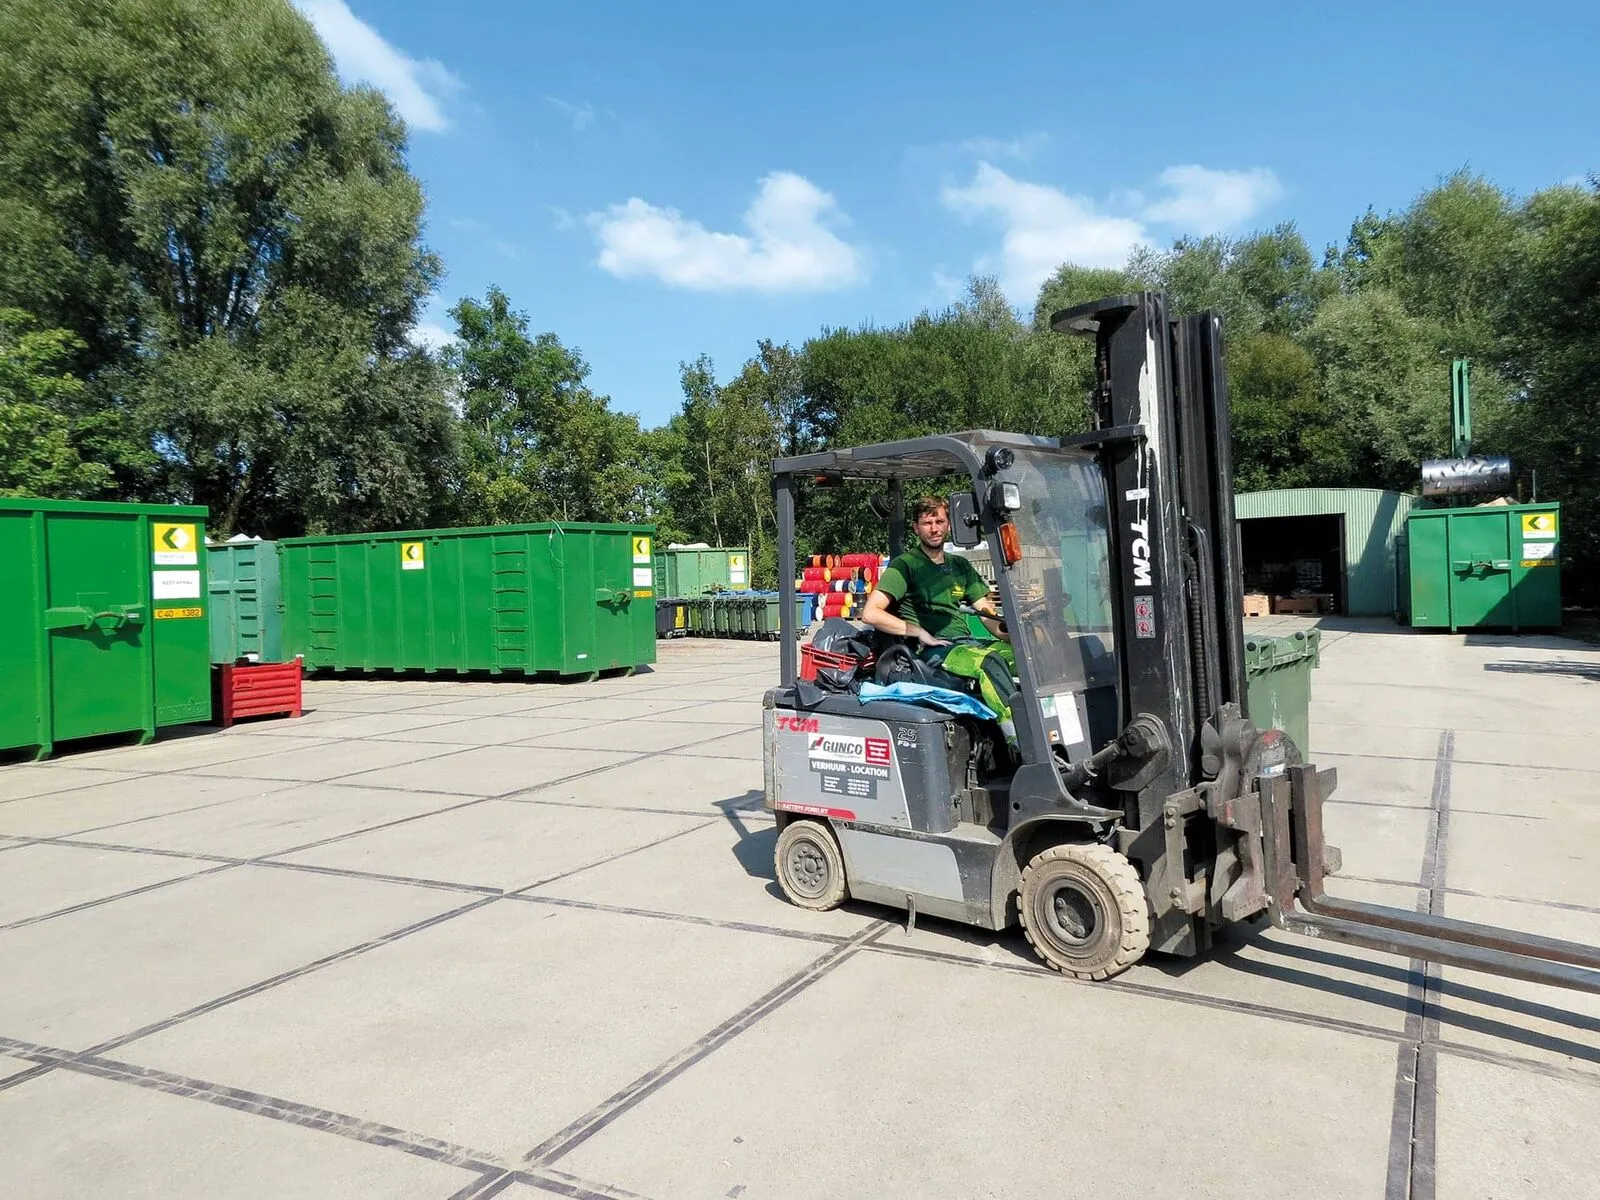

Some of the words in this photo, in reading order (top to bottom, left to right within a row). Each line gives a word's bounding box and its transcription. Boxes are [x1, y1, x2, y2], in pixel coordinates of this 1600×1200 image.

[1130, 518, 1152, 586] TCM
[777, 717, 818, 733] TCM
[897, 727, 917, 741] 25
[823, 741, 863, 755] GUNCO
[811, 761, 846, 772] VERHUUR
[850, 765, 888, 778] LOCATION
